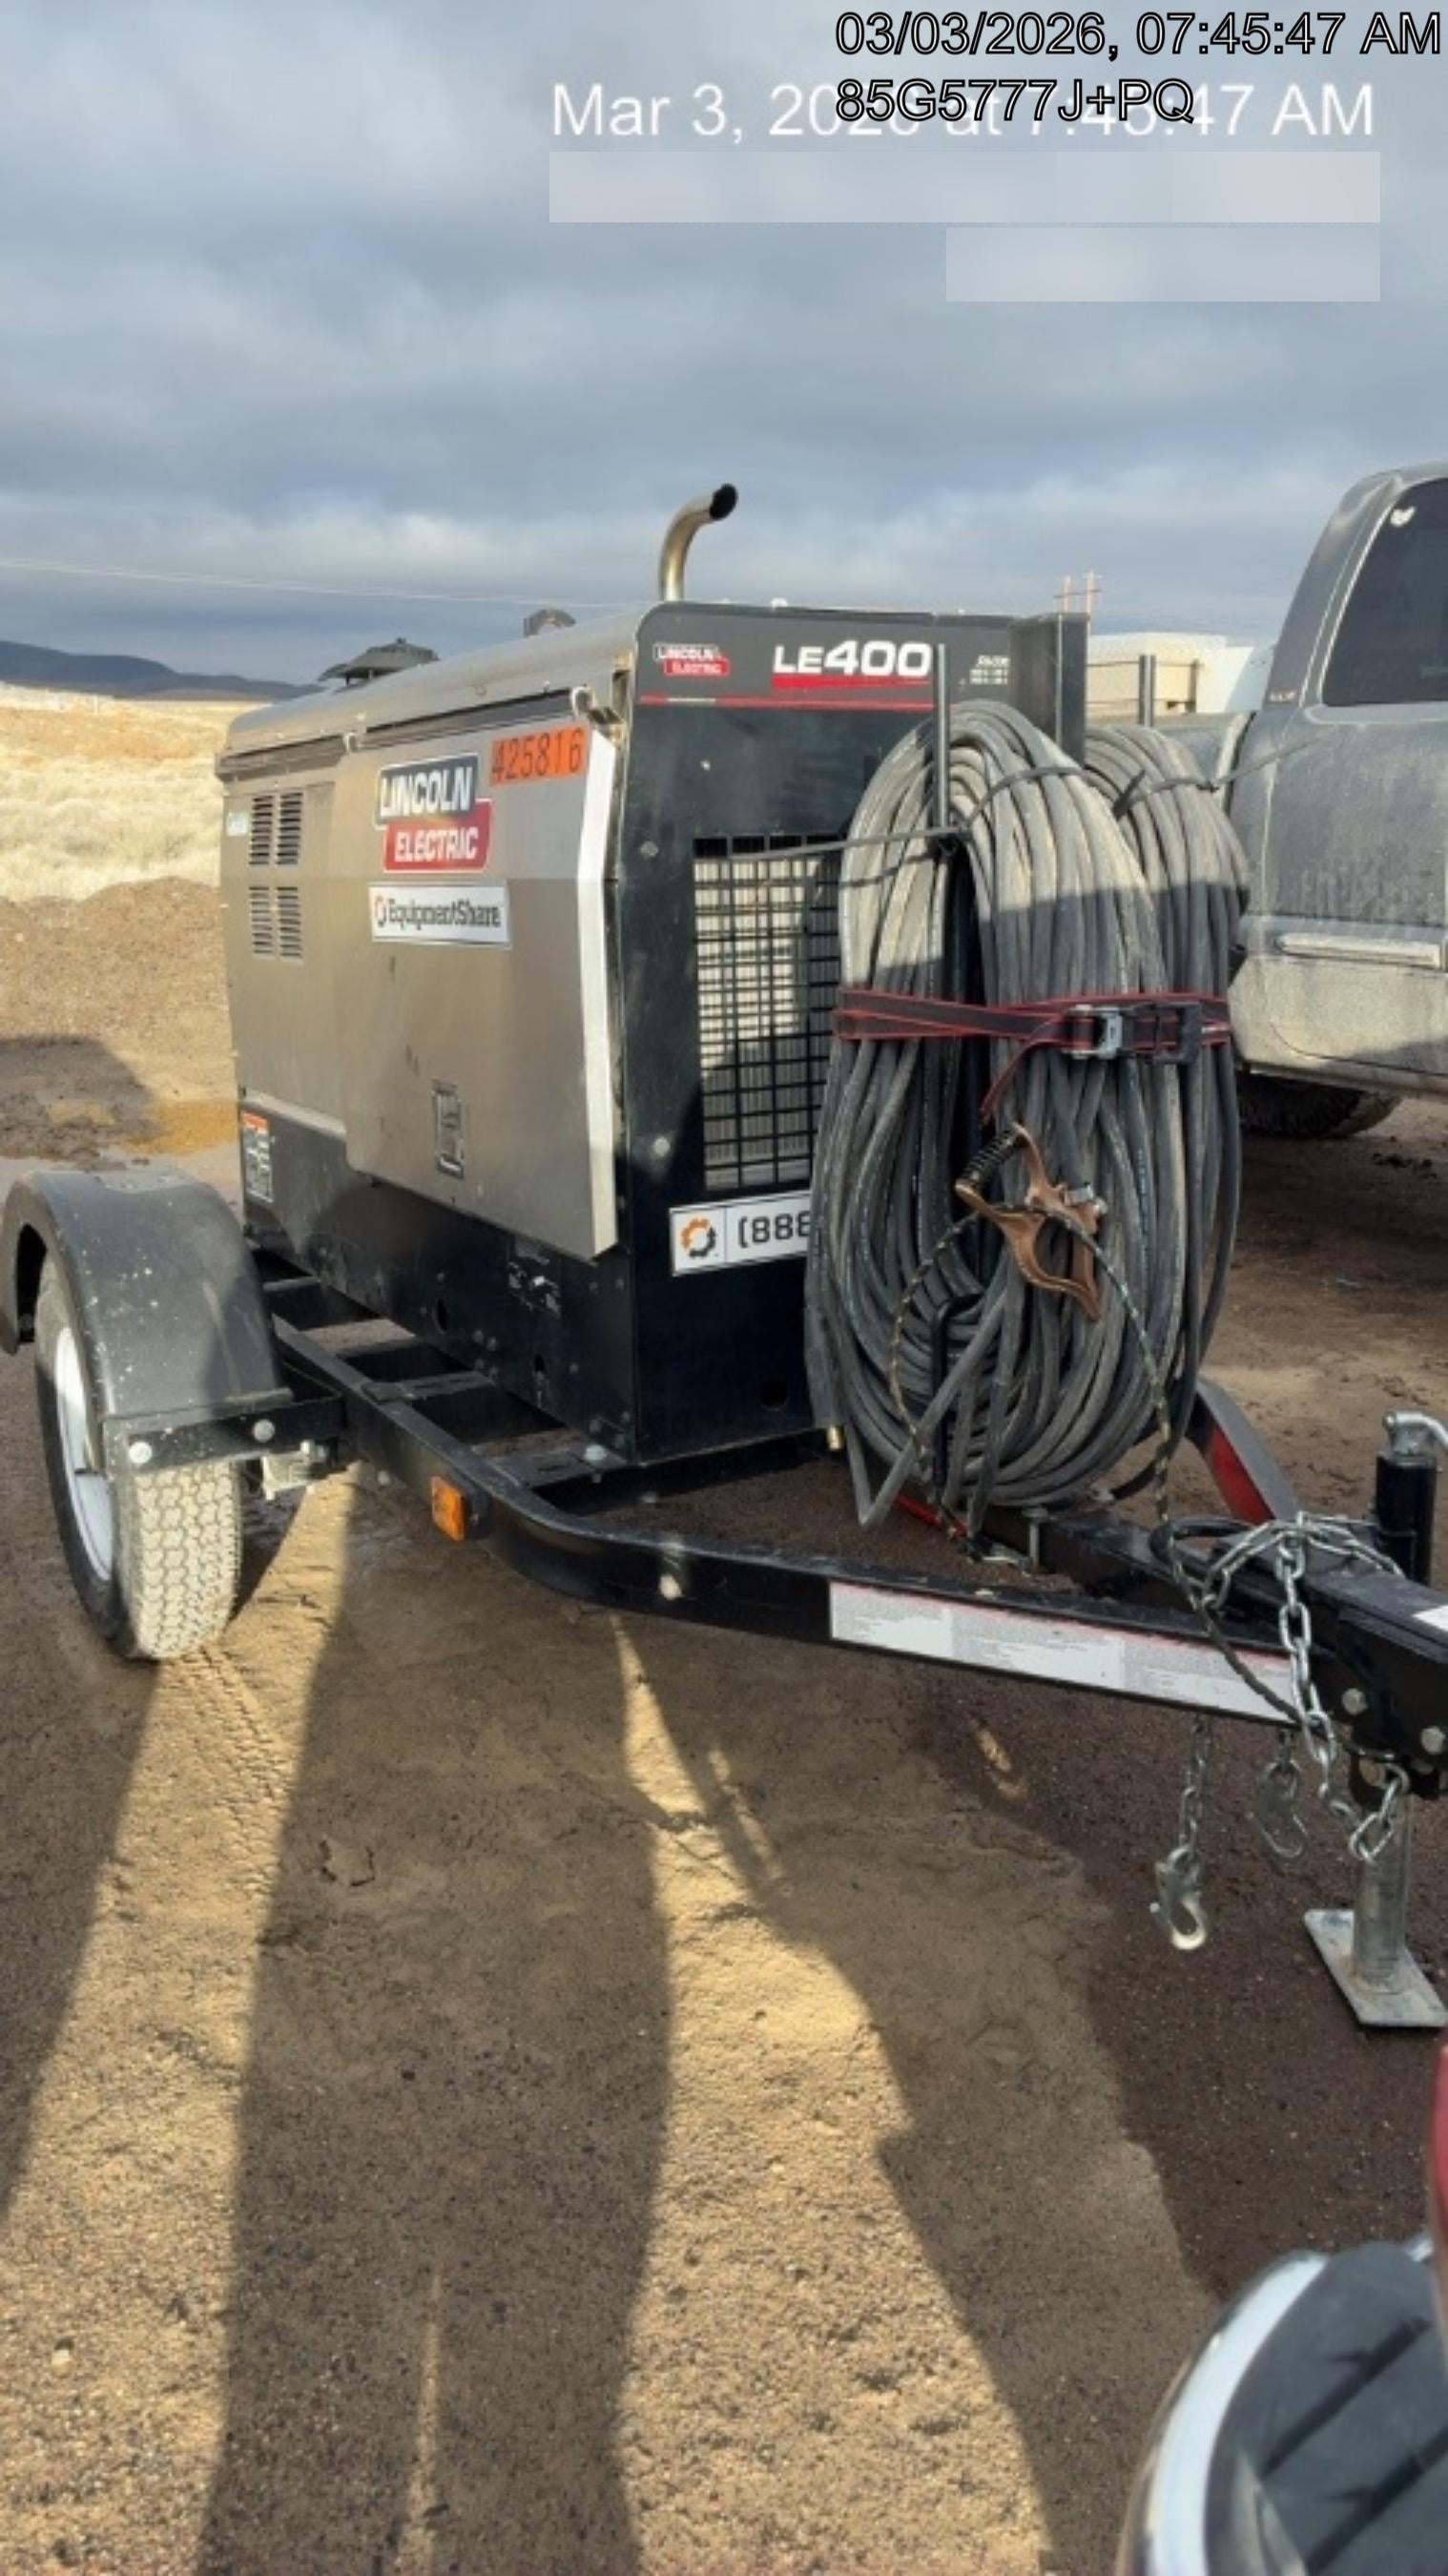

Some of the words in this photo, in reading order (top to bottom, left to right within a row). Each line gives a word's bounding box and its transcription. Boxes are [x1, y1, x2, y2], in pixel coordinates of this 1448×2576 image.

[774, 640, 932, 676] LE400
[379, 766, 474, 818] LINCOLN
[394, 827, 479, 863] ELECTRIC
[387, 898, 502, 931] EquipmentShare
